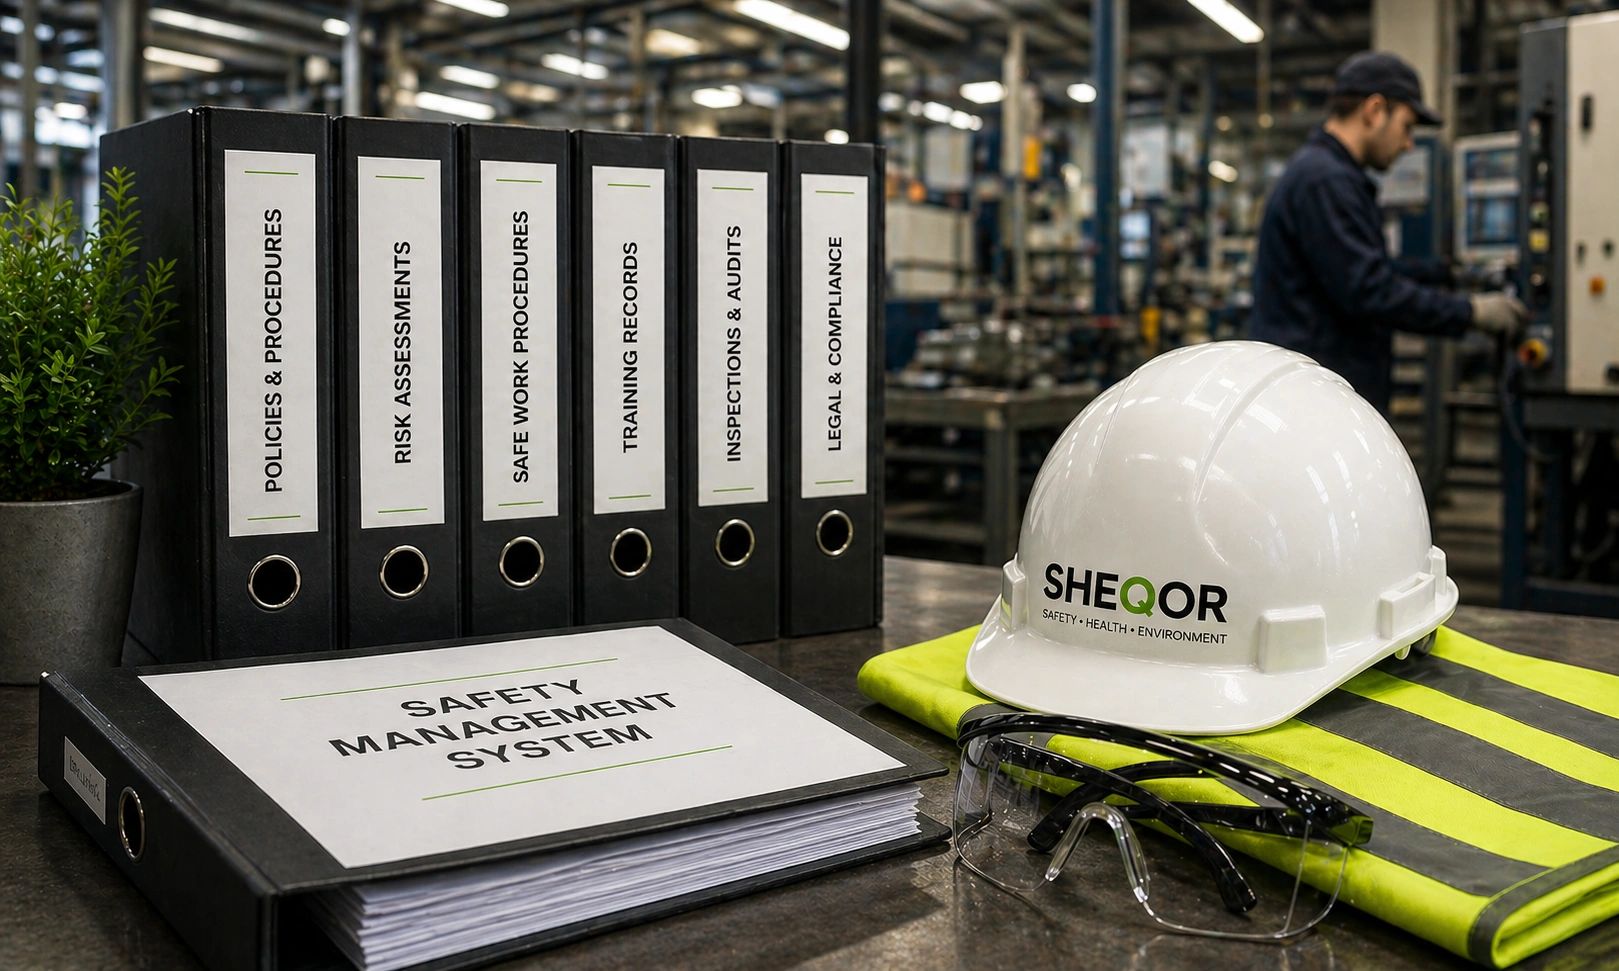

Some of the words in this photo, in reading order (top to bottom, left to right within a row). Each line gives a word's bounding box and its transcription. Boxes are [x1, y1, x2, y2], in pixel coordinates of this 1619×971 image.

[264, 208, 283, 363] PROCEDURES
[512, 210, 529, 354] PROCEDURES
[622, 242, 638, 344] RECORDS
[726, 225, 742, 302] AUDITS
[393, 241, 412, 407] ASSESSMENTS
[726, 307, 742, 322] &
[828, 236, 842, 366] COMPLIANCE
[264, 370, 283, 386] &
[512, 359, 529, 426] WORK
[622, 350, 638, 454] TRAINING
[726, 327, 742, 462] INSPECTIONS
[827, 371, 842, 385] &
[264, 392, 283, 493] POLICIES
[394, 413, 412, 464] RISK
[827, 390, 842, 452] LEGAL
[512, 431, 529, 483] SAFE
[1043, 563, 1228, 623] SHEQOR
[1043, 608, 1077, 625] SAFETY
[1086, 618, 1127, 634] HEALTH
[1138, 627, 1227, 644] ENVIRONMENT
[328, 692, 678, 757] MANAGEMENT
[400, 679, 584, 717] SAFETY
[446, 724, 654, 770] SYSTEM
